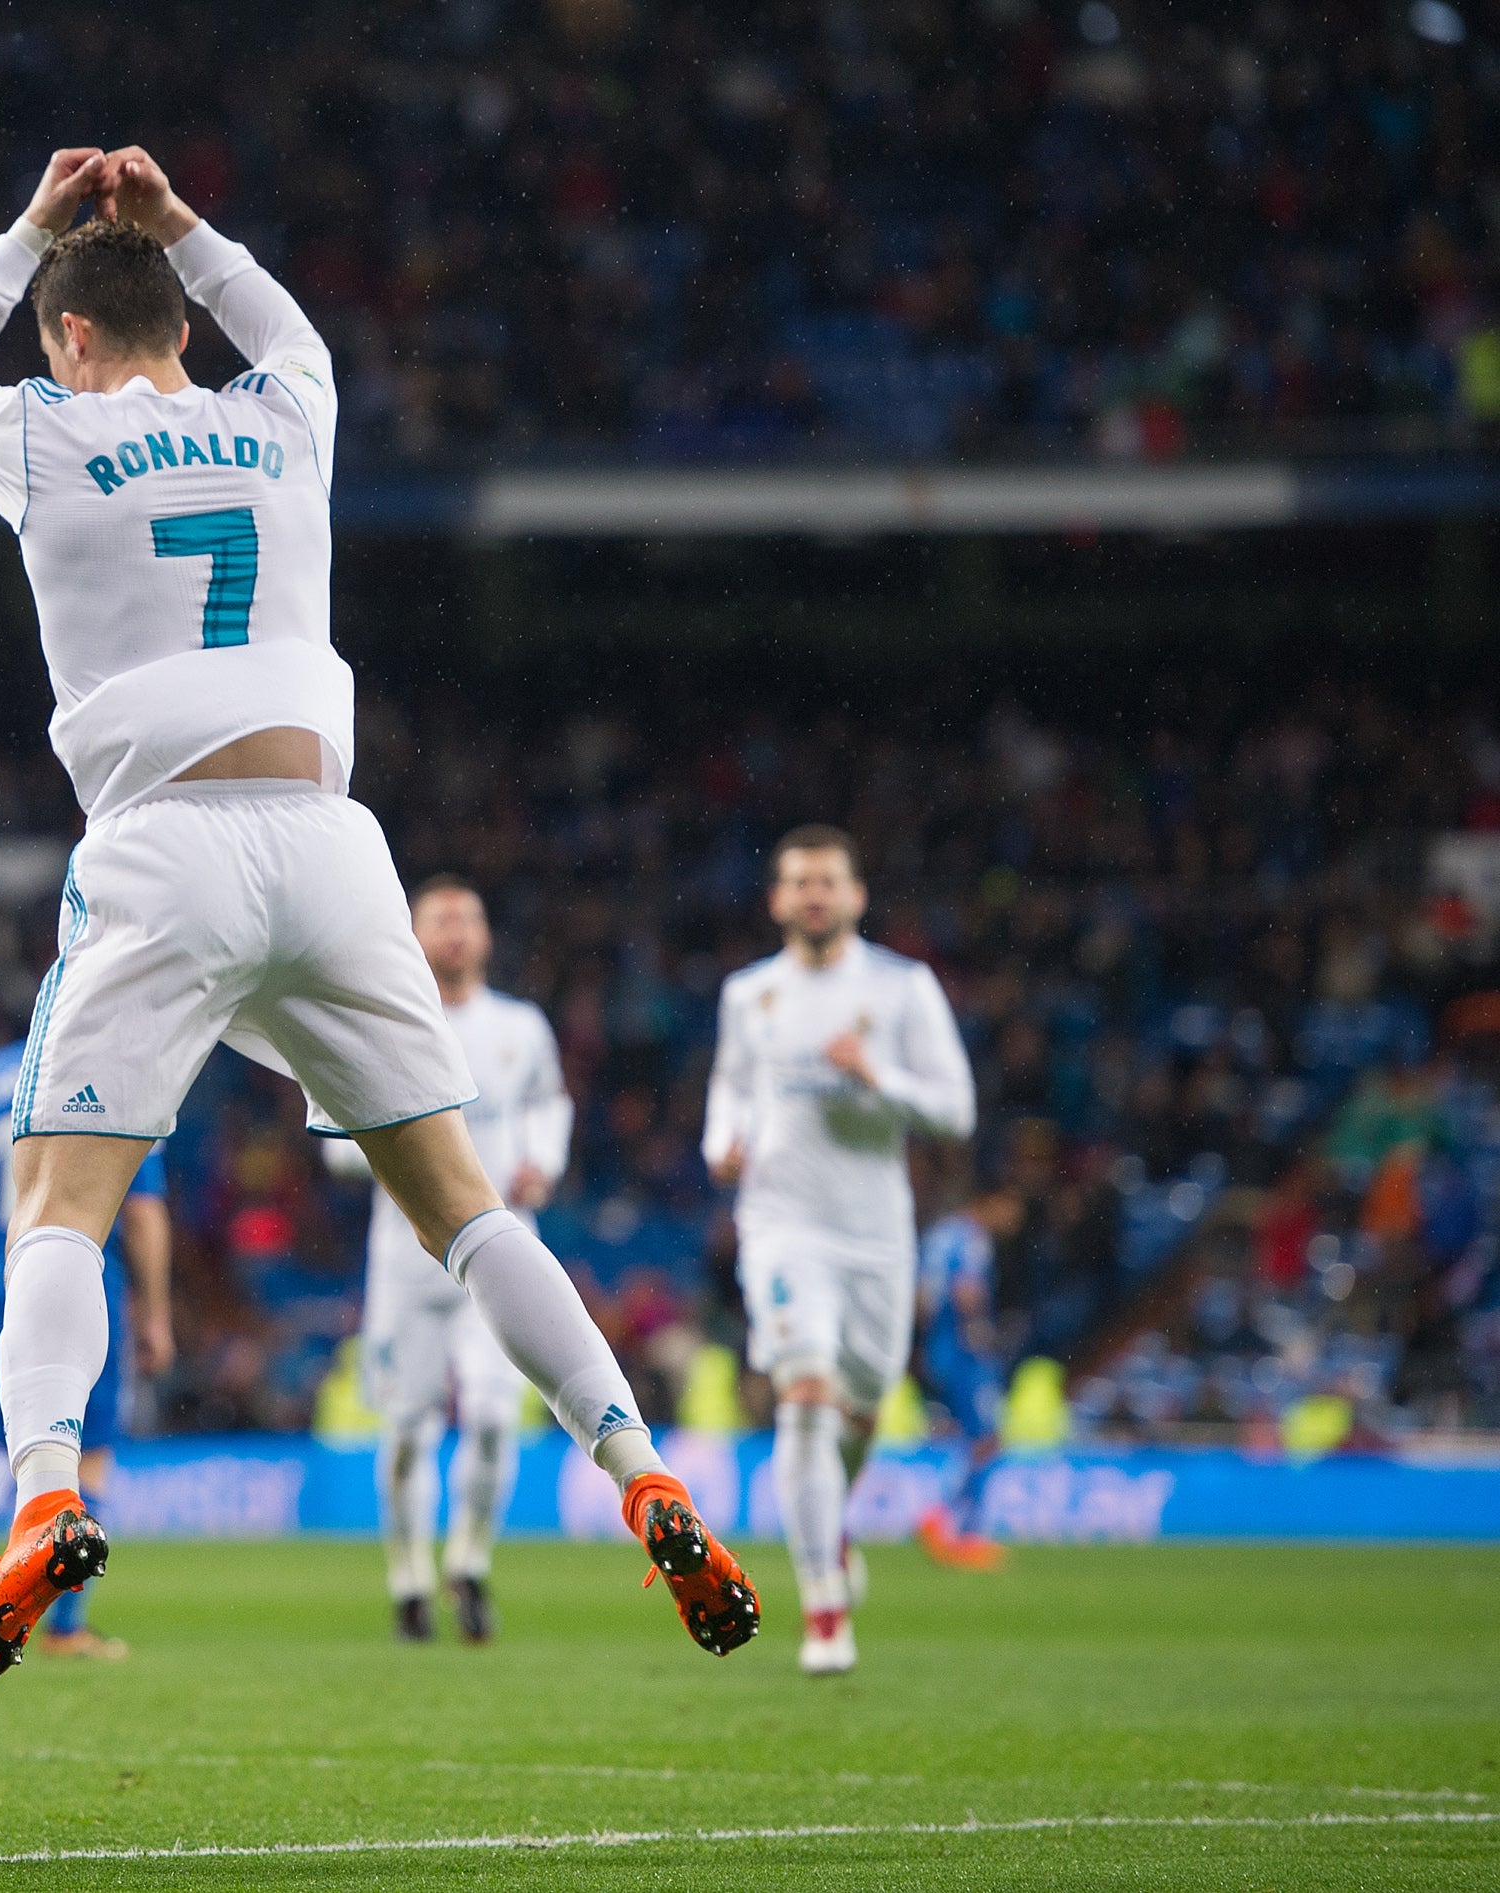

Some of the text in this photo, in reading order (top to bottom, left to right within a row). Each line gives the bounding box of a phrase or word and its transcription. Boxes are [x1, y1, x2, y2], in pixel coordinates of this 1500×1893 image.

[85, 430, 284, 496] RONALDO
[150, 507, 258, 650] 7
[62, 1102, 106, 1114] adidas
[596, 1417, 638, 1440] adidas
